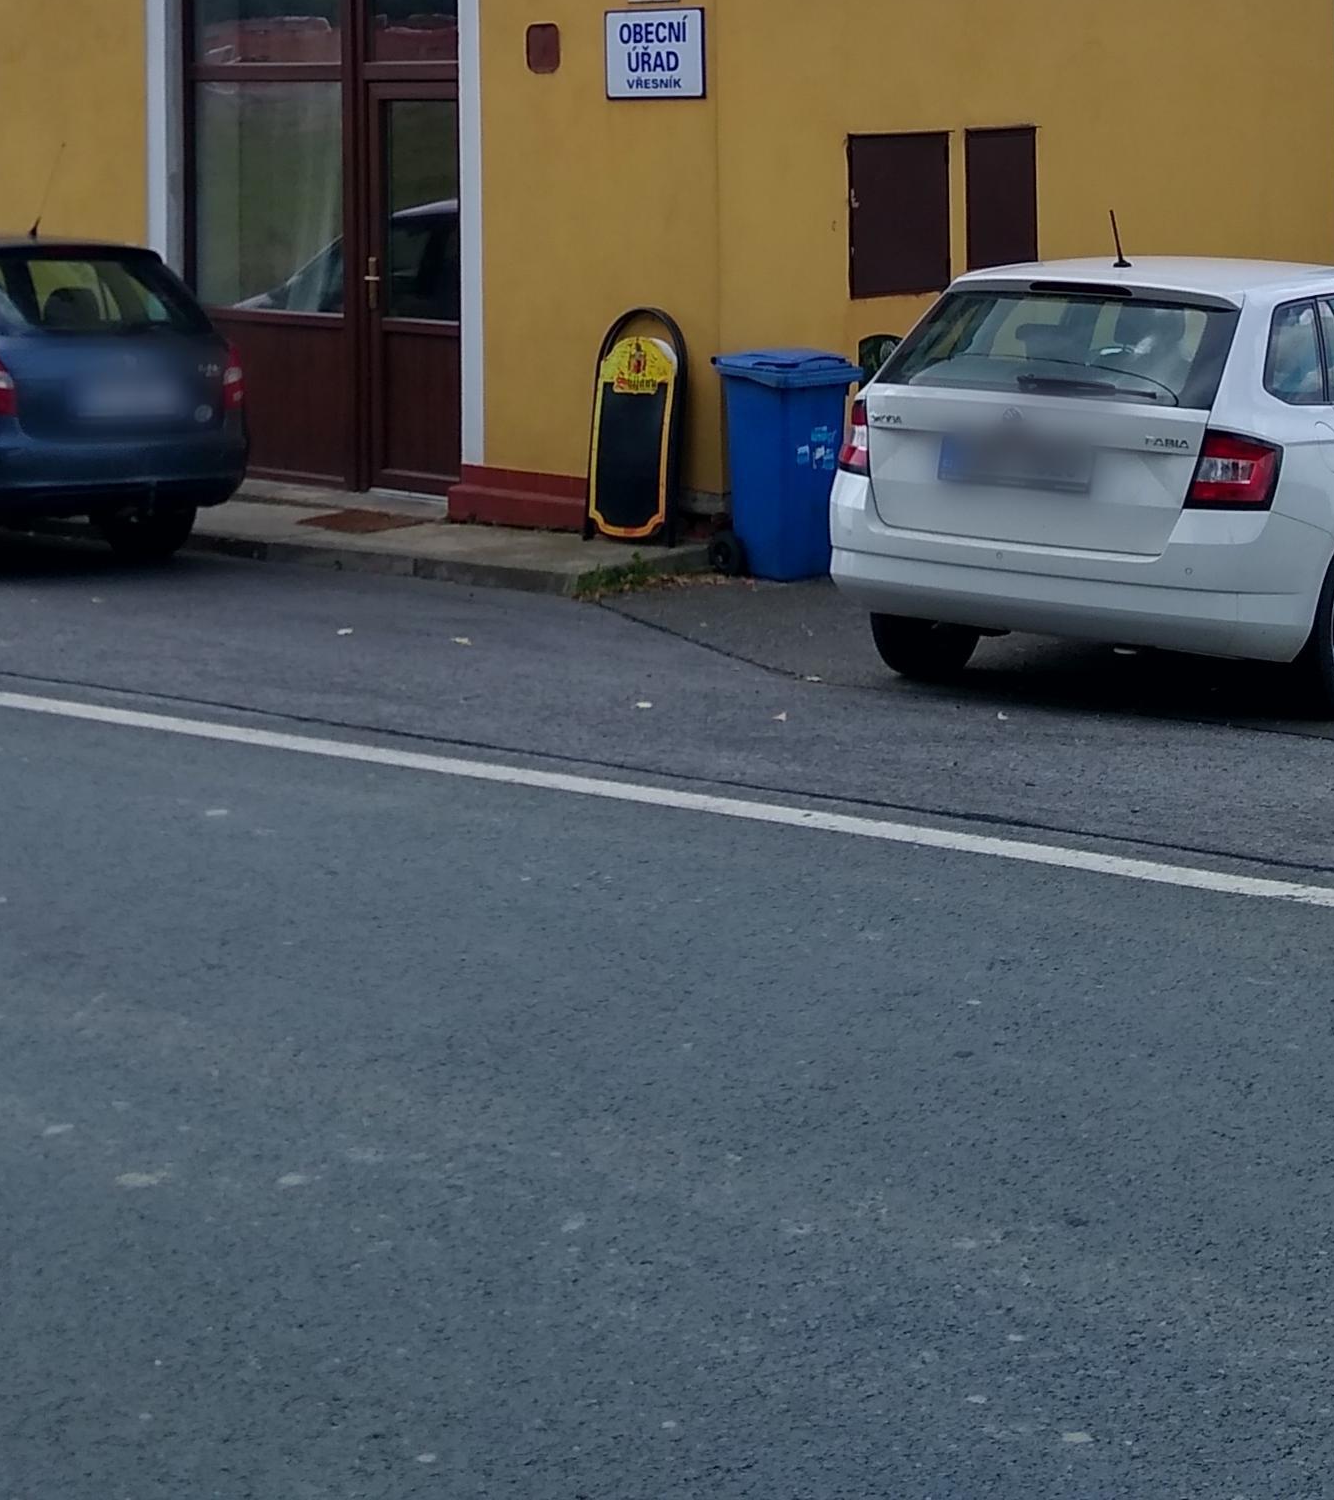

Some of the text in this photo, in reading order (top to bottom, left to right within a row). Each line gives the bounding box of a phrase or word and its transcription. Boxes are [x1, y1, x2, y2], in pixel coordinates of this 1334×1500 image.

[618, 14, 688, 44] OBECNÍ
[627, 45, 680, 73] ÚŘAD
[626, 75, 682, 90] VŘESNÍK
